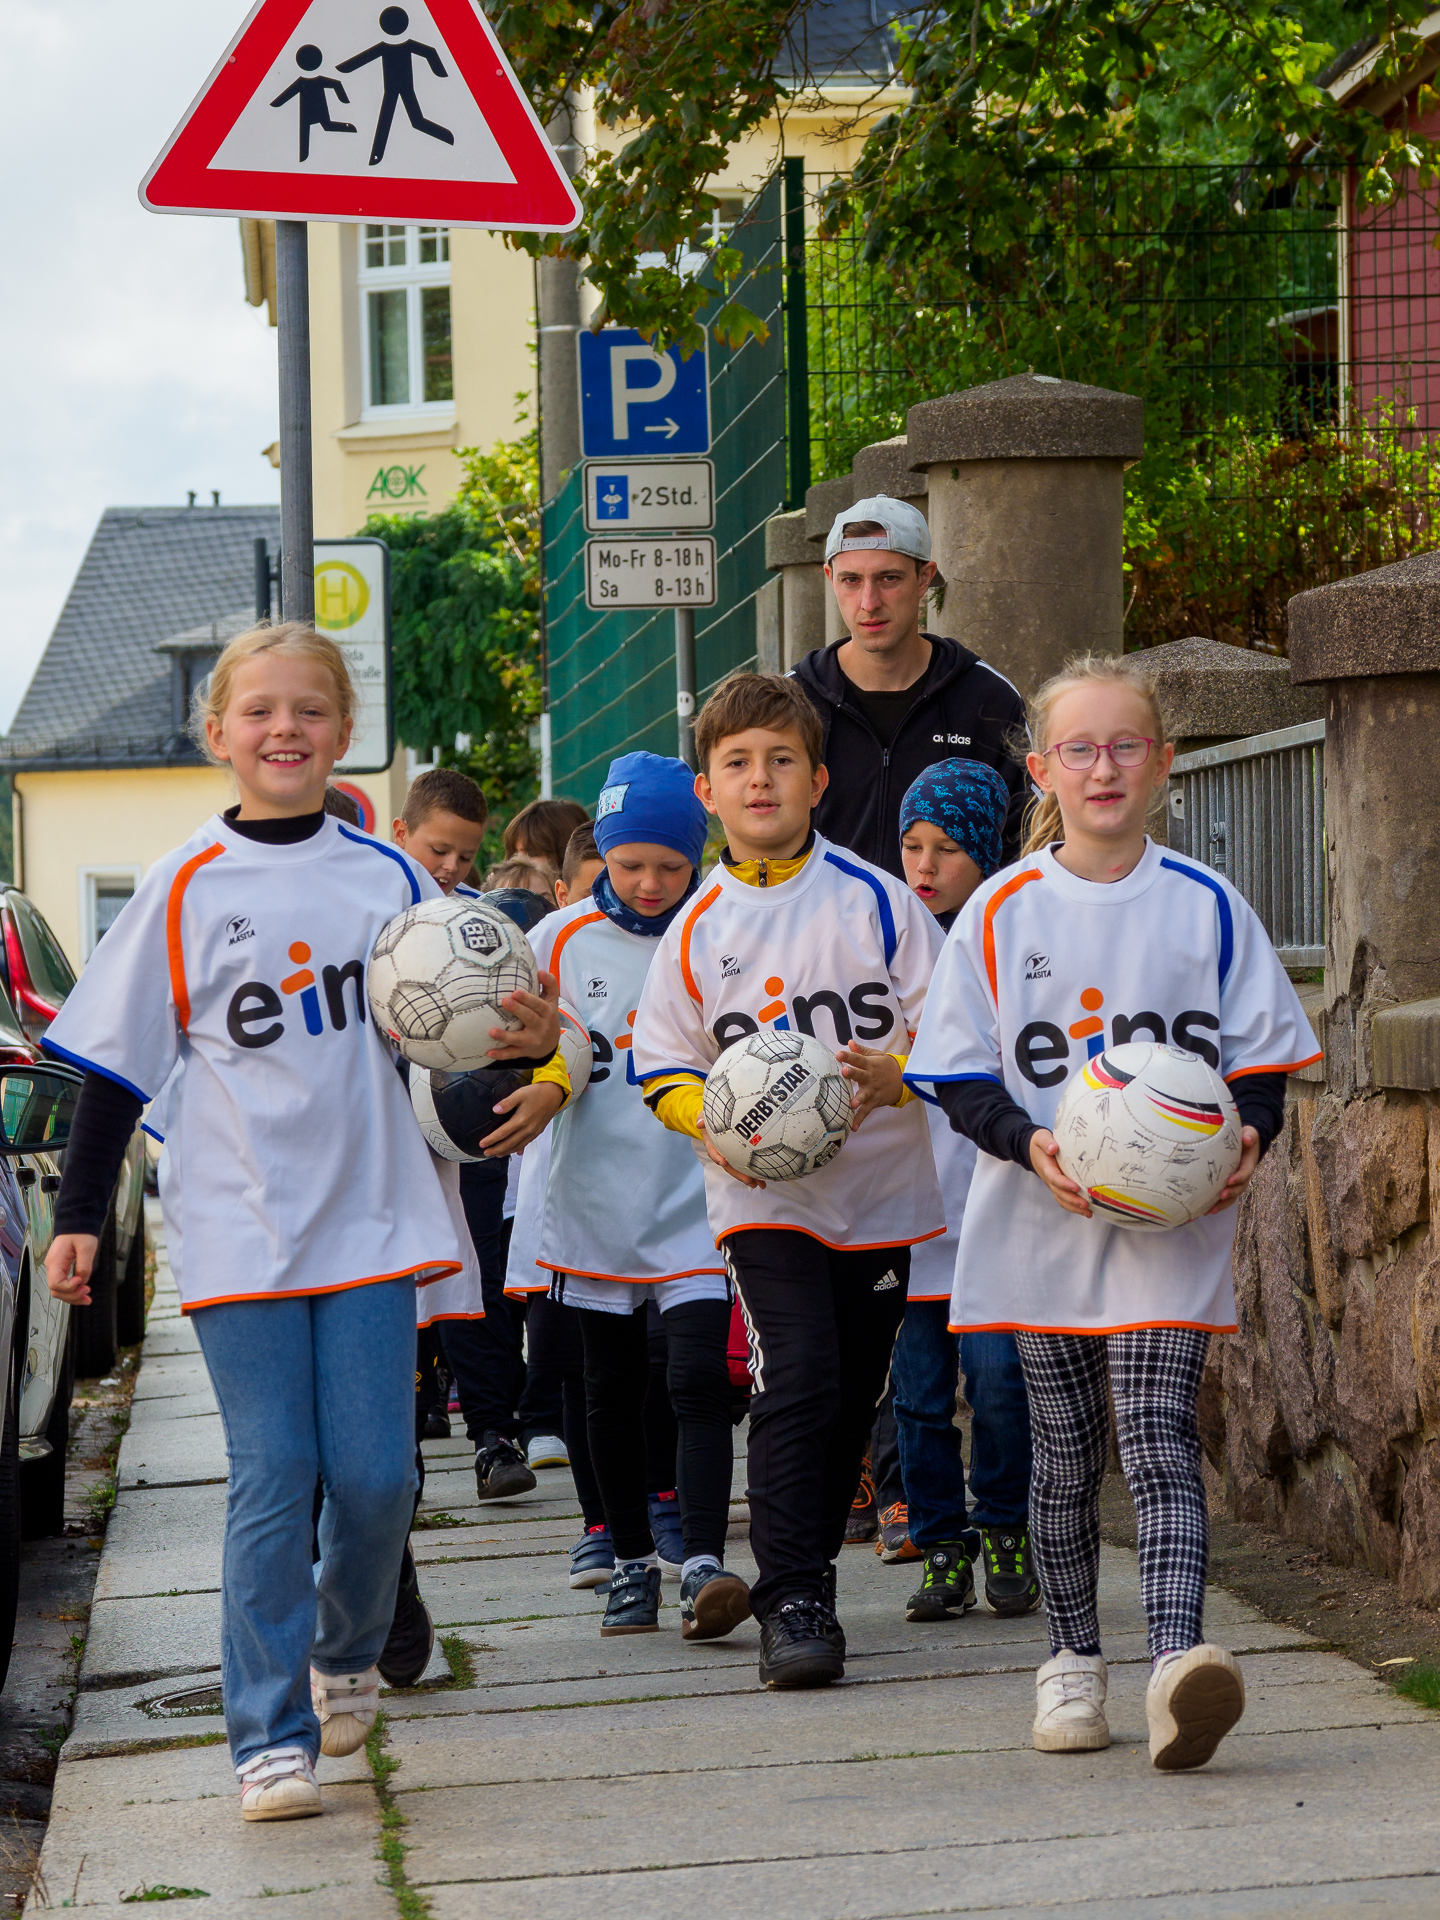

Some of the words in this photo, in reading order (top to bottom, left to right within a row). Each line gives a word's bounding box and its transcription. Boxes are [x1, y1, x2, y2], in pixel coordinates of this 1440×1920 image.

[610, 345, 677, 440] P
[366, 464, 428, 500] AOK
[599, 549, 646, 568] Mo-Fr
[320, 576, 348, 614] H
[600, 580, 619, 598] Sa
[229, 929, 256, 946] MASITA
[1024, 970, 1052, 980] MASITA
[734, 1063, 811, 1140] DERBYSTAR
[873, 1280, 900, 1291] adidas
[612, 1576, 629, 1588] LICO
